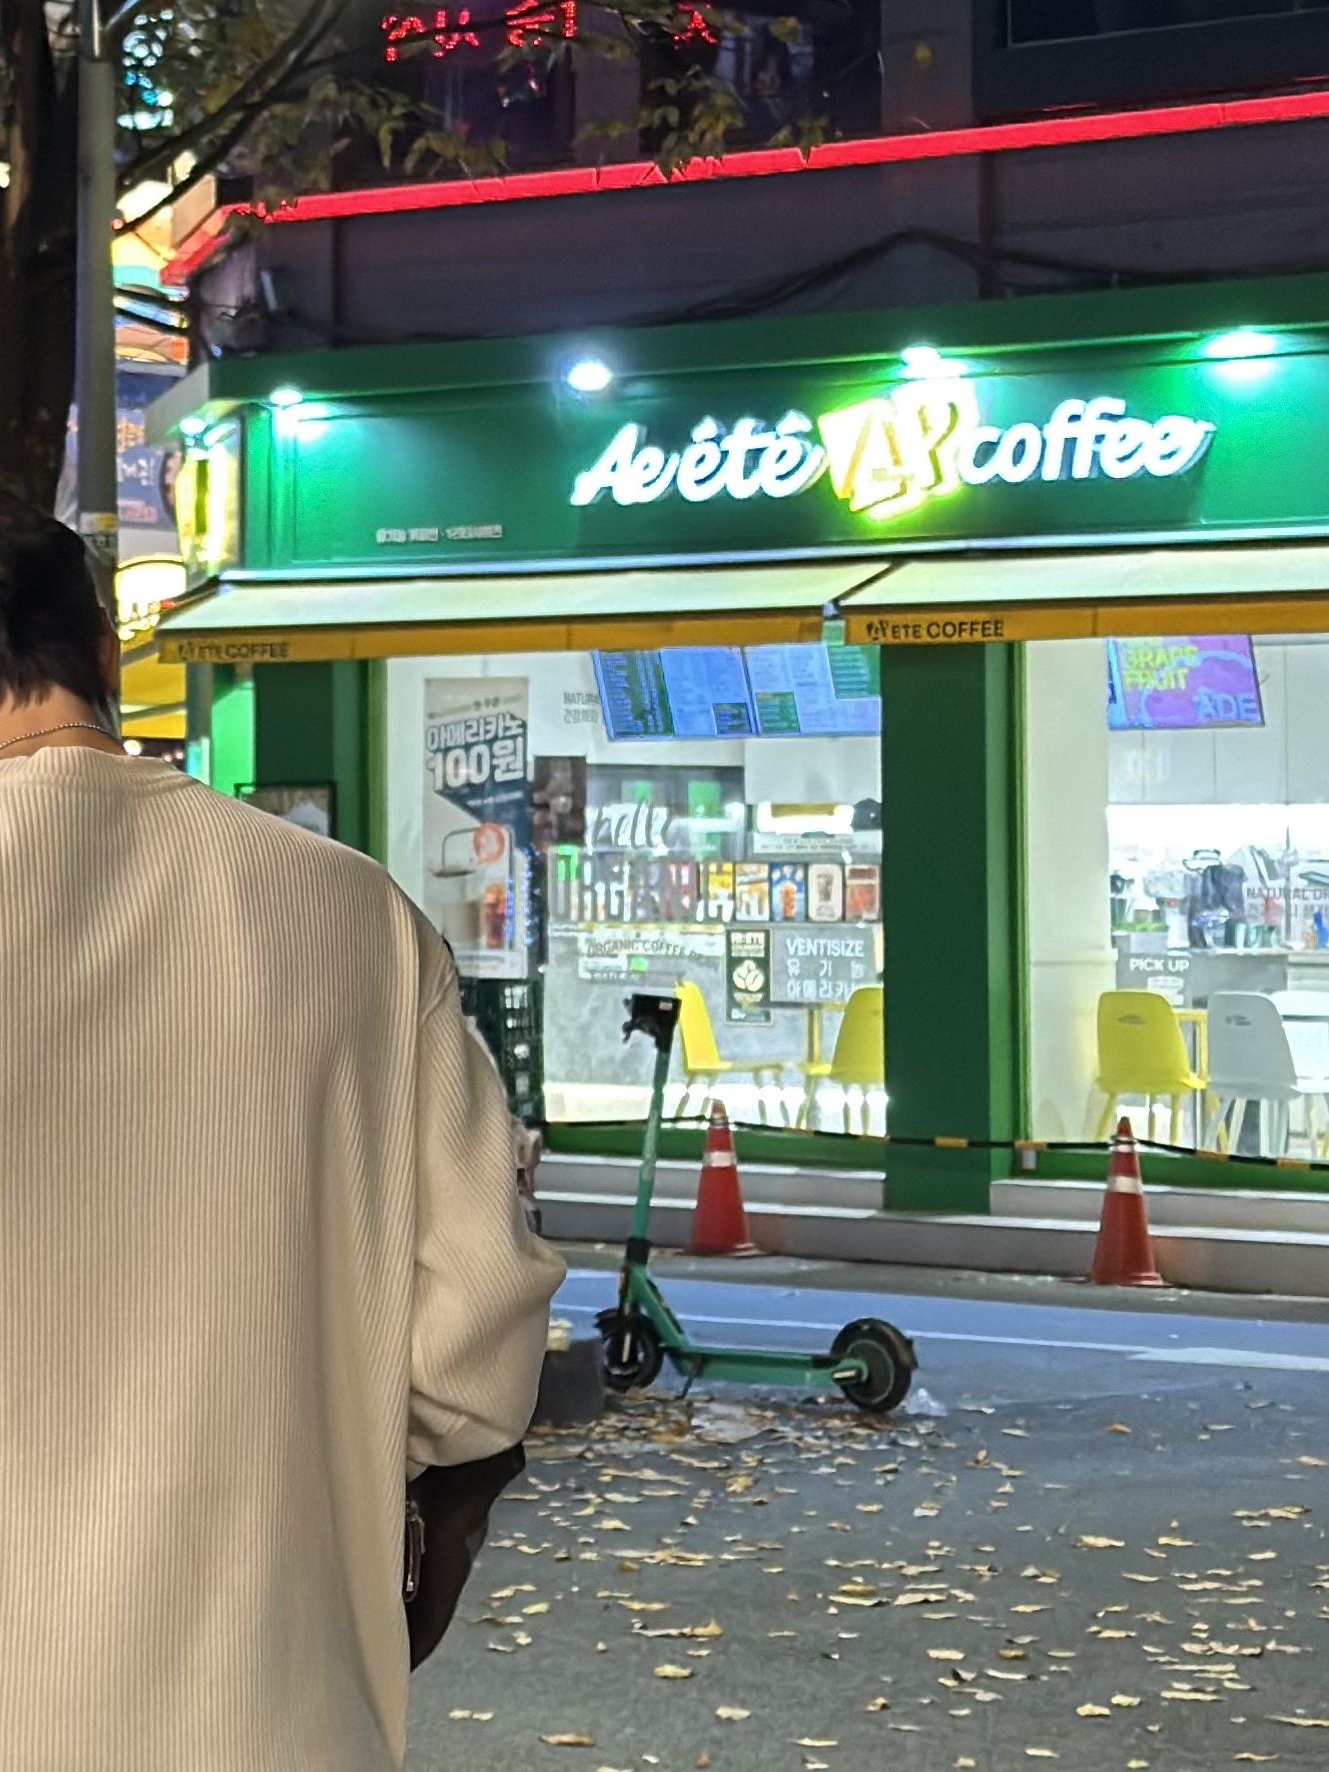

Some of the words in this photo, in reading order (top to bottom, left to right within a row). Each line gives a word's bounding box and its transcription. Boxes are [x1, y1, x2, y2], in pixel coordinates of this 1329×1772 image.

[957, 396, 1216, 485] coffee
[926, 620, 1005, 639] COFFEE
[225, 641, 289, 658] COFFEE
[1194, 689, 1260, 721] ADE
[426, 711, 524, 753] 아메리카노
[426, 736, 524, 791] 100원
[785, 937, 865, 958] VENTISIZE
[1129, 958, 1164, 972] PICK
[1168, 958, 1190, 973] UP
[786, 977, 855, 999] 아메리카
